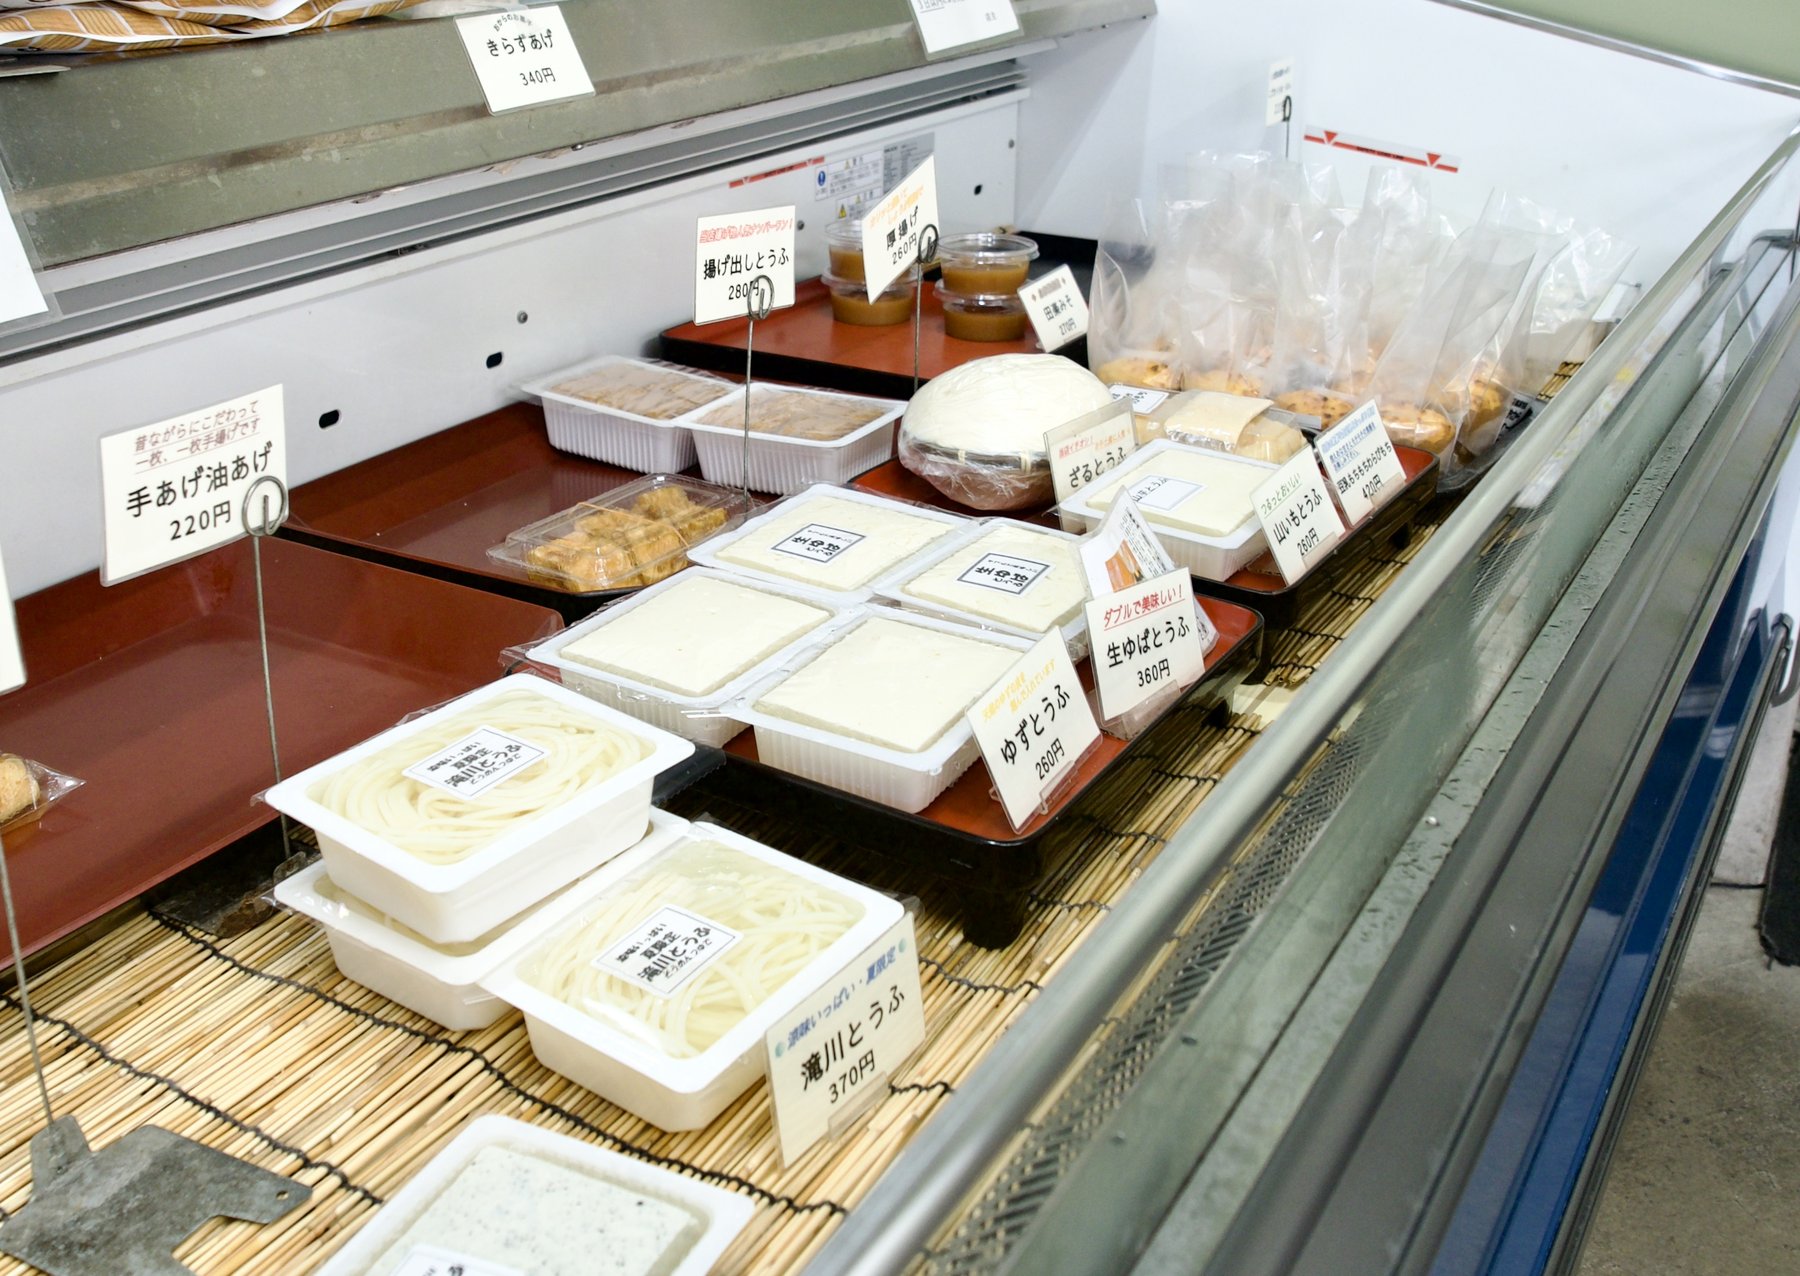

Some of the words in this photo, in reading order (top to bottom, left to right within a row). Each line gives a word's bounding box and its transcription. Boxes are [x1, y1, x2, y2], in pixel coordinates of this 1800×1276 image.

[487, 29, 553, 57] きらずあげ
[520, 68, 556, 86] 340円
[703, 247, 789, 280] 揚げ出しとうふ
[892, 232, 917, 265] 260円
[728, 279, 760, 301] 280円
[134, 400, 259, 452] 昔ながらにこだわって
[126, 440, 273, 518] 手あげ油あげ
[1069, 446, 1127, 488] ざるとうふ
[1362, 474, 1385, 501] 420円
[169, 500, 231, 541] 220円
[1272, 488, 1323, 545] 山いもとうふ
[1296, 527, 1321, 556] 260円
[1103, 583, 1183, 629] ダブルで美味しい！
[1106, 616, 1190, 669] 生ゆばとうふ
[1136, 657, 1171, 688] 360円
[1000, 684, 1070, 766] ゆずとうふ
[444, 744, 523, 788] 滝川とうふ
[1035, 738, 1065, 780] 260円
[637, 926, 712, 982] 滝川とうふ
[800, 984, 906, 1091] 滝川とうふ
[828, 1049, 876, 1104] 370円
